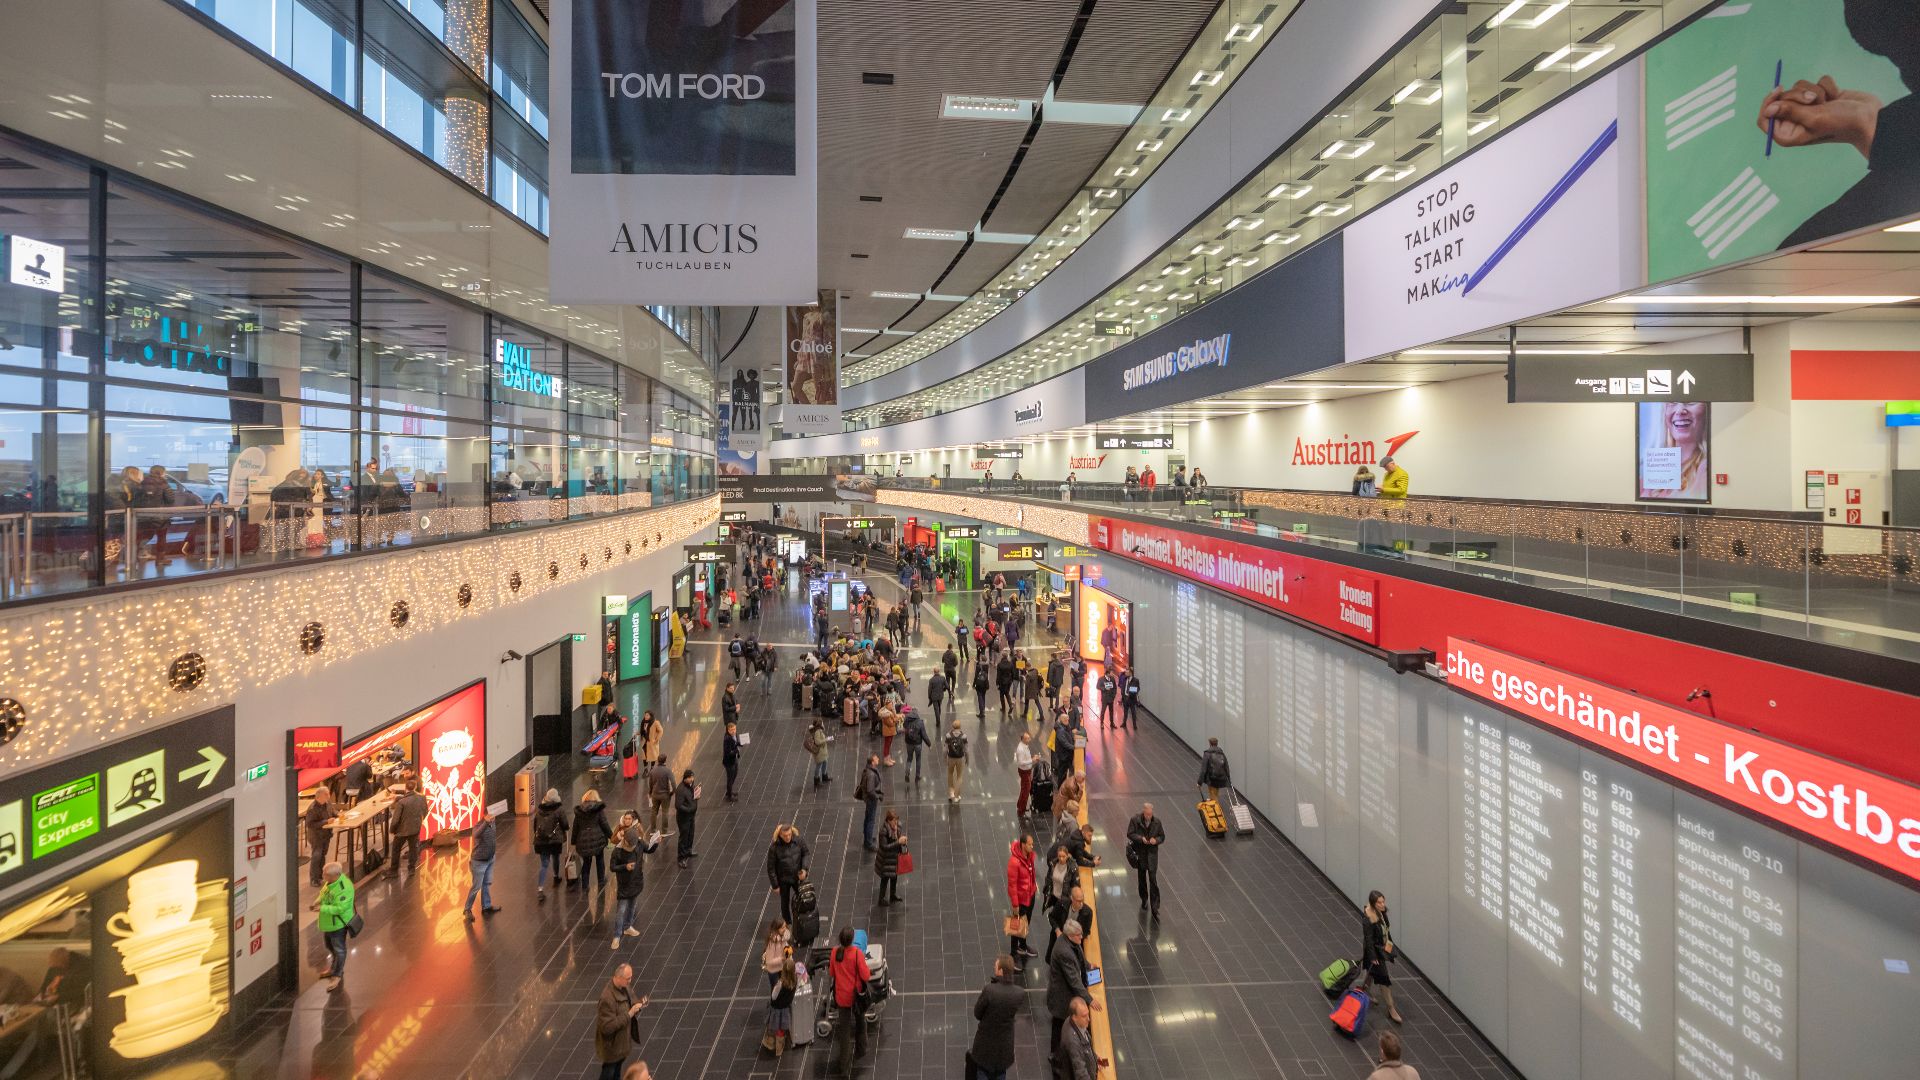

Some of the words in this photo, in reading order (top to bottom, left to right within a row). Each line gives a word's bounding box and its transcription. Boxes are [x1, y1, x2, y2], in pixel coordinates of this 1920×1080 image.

[601, 72, 671, 98] TOM
[678, 73, 766, 100] FORD
[1404, 203, 1476, 251] TALKING
[1417, 181, 1459, 218] STOP
[609, 222, 759, 254] AMICIS
[636, 261, 732, 270] TUCHLAUBEN
[1413, 238, 1464, 274] START
[790, 338, 833, 354] Chloé
[1123, 352, 1177, 391] SAMSUNG
[1177, 333, 1231, 372] Galaxy
[1575, 378, 1607, 387] Ausgang
[797, 414, 830, 423] AMICIS
[1069, 454, 1097, 470] Austrian
[1291, 433, 1377, 466] Austrian
[1175, 540, 1215, 578] Bestens
[1218, 549, 1289, 603] informiert.
[1339, 580, 1373, 608] Kronen
[1340, 602, 1373, 634] Zeitung
[1491, 669, 1680, 764] geschändet
[37, 784, 78, 806] CAT
[38, 810, 69, 830] City
[1479, 722, 1502, 739] 09:20
[1508, 736, 1532, 754] GRAZ
[1582, 770, 1598, 785] OS
[1611, 783, 1633, 802] 970
[1677, 814, 1715, 841] landed
[1742, 845, 1783, 874] 09:10
[1508, 750, 1542, 773] ZAGREB
[1582, 786, 1598, 801] OS
[1611, 800, 1633, 819] 682
[1678, 835, 1750, 881] approaching
[38, 816, 93, 848] Express
[1479, 763, 1502, 780] 09:30
[1508, 778, 1543, 804] MUNICH
[1582, 818, 1598, 833] OS
[1612, 834, 1633, 854] 112
[1678, 872, 1733, 909] expected
[1742, 905, 1783, 936] 09:38
[1479, 776, 1502, 794] 09:30
[1508, 792, 1540, 817] LEIPZIG
[1582, 834, 1598, 850] OS
[1612, 851, 1633, 870] 216
[1678, 889, 1750, 941] approaching
[1508, 764, 1563, 799] NUREMBERG
[1582, 802, 1599, 817] EW
[1611, 817, 1641, 840] 5807
[1678, 853, 1733, 889] expected
[1742, 886, 1783, 916] 09:34
[1508, 807, 1551, 839] ISTANBUL
[1583, 850, 1598, 865] PC
[1612, 867, 1633, 887] 901
[1678, 908, 1733, 948] expected
[1742, 945, 1783, 978] 09:28
[1509, 821, 1534, 842] SOFIA
[1583, 865, 1598, 882] OE
[1612, 884, 1634, 904] 183
[1678, 926, 1733, 968] expected
[1743, 965, 1782, 999] 10:01
[1509, 877, 1536, 902] MILAN
[1540, 899, 1560, 918] MXP
[1583, 930, 1599, 947] OS
[1509, 834, 1552, 870] HANOVER
[1583, 882, 1600, 898] EW
[1678, 944, 1733, 987] expected
[1742, 985, 1783, 1019] 09:36
[1509, 849, 1548, 881] HELSINKI
[1583, 898, 1598, 914] AY
[1612, 917, 1641, 944] 1471
[1678, 963, 1733, 1007] expected
[1742, 1005, 1783, 1039] 09:47
[1509, 864, 1537, 888] OHRID
[1612, 933, 1641, 961] 2826
[1678, 981, 1733, 1026] expected
[1742, 1025, 1783, 1061] 09:43
[1509, 920, 1564, 967] FRANKFURT
[1583, 977, 1598, 995] LH
[1612, 1000, 1642, 1031] 1234
[1509, 891, 1564, 938] BARCELONA
[1612, 967, 1642, 996] 8714
[1678, 1017, 1733, 1065] expected
[1509, 905, 1523, 922] ST.
[1678, 1036, 1733, 1080] expected
